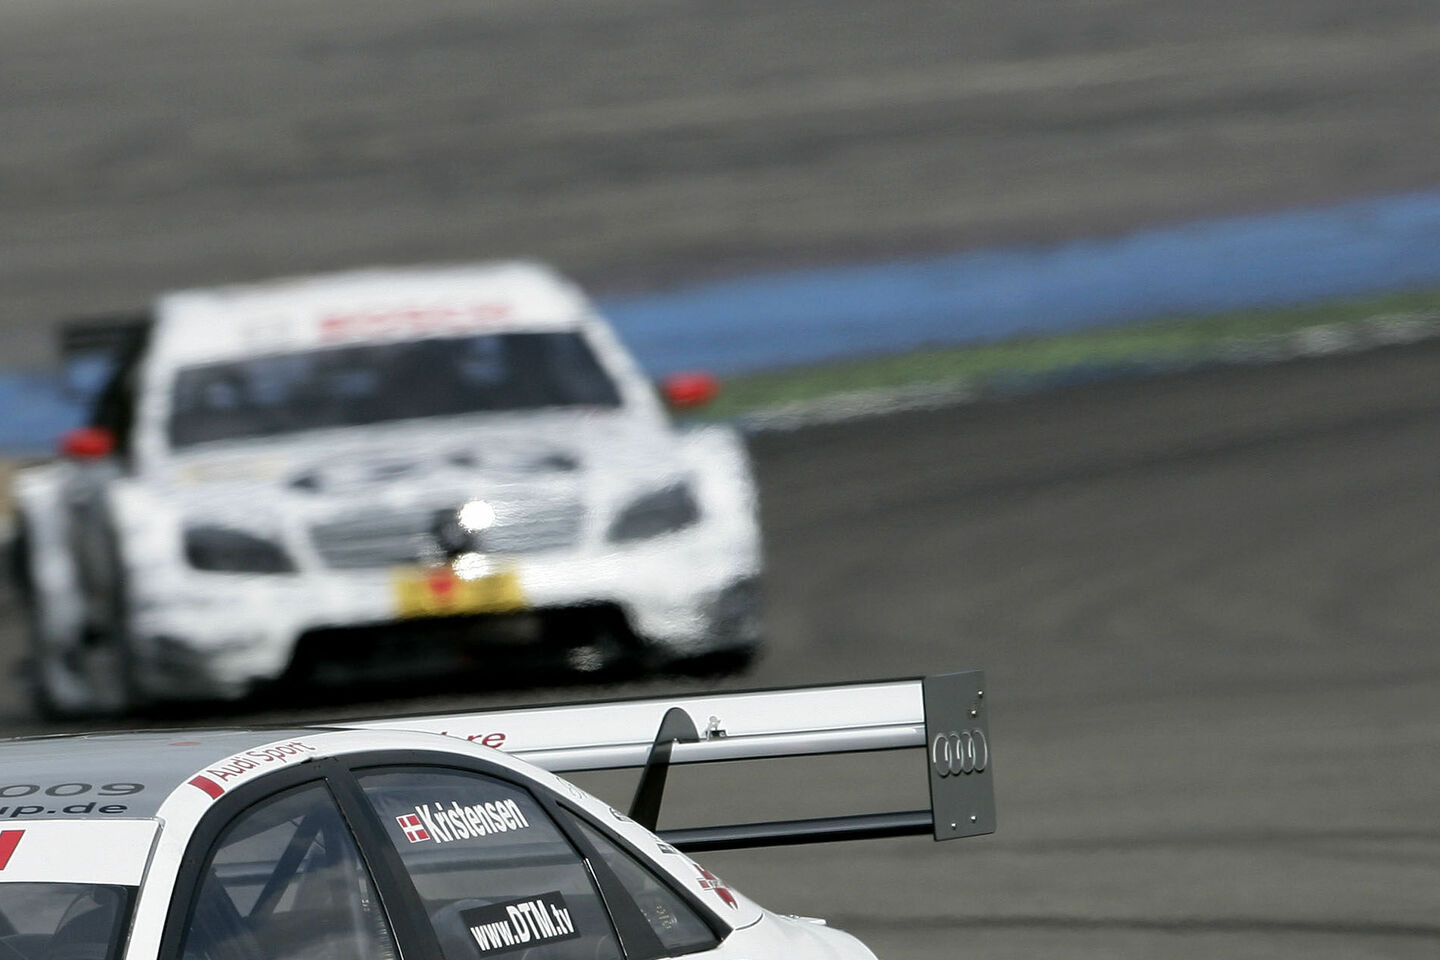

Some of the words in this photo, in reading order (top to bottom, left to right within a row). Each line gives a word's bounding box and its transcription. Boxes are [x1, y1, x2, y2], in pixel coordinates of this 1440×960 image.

[205, 755, 262, 783] Audi
[245, 740, 317, 764] Sport
[415, 799, 530, 844] Kristensen
[470, 900, 576, 951] www.DTM.tv
